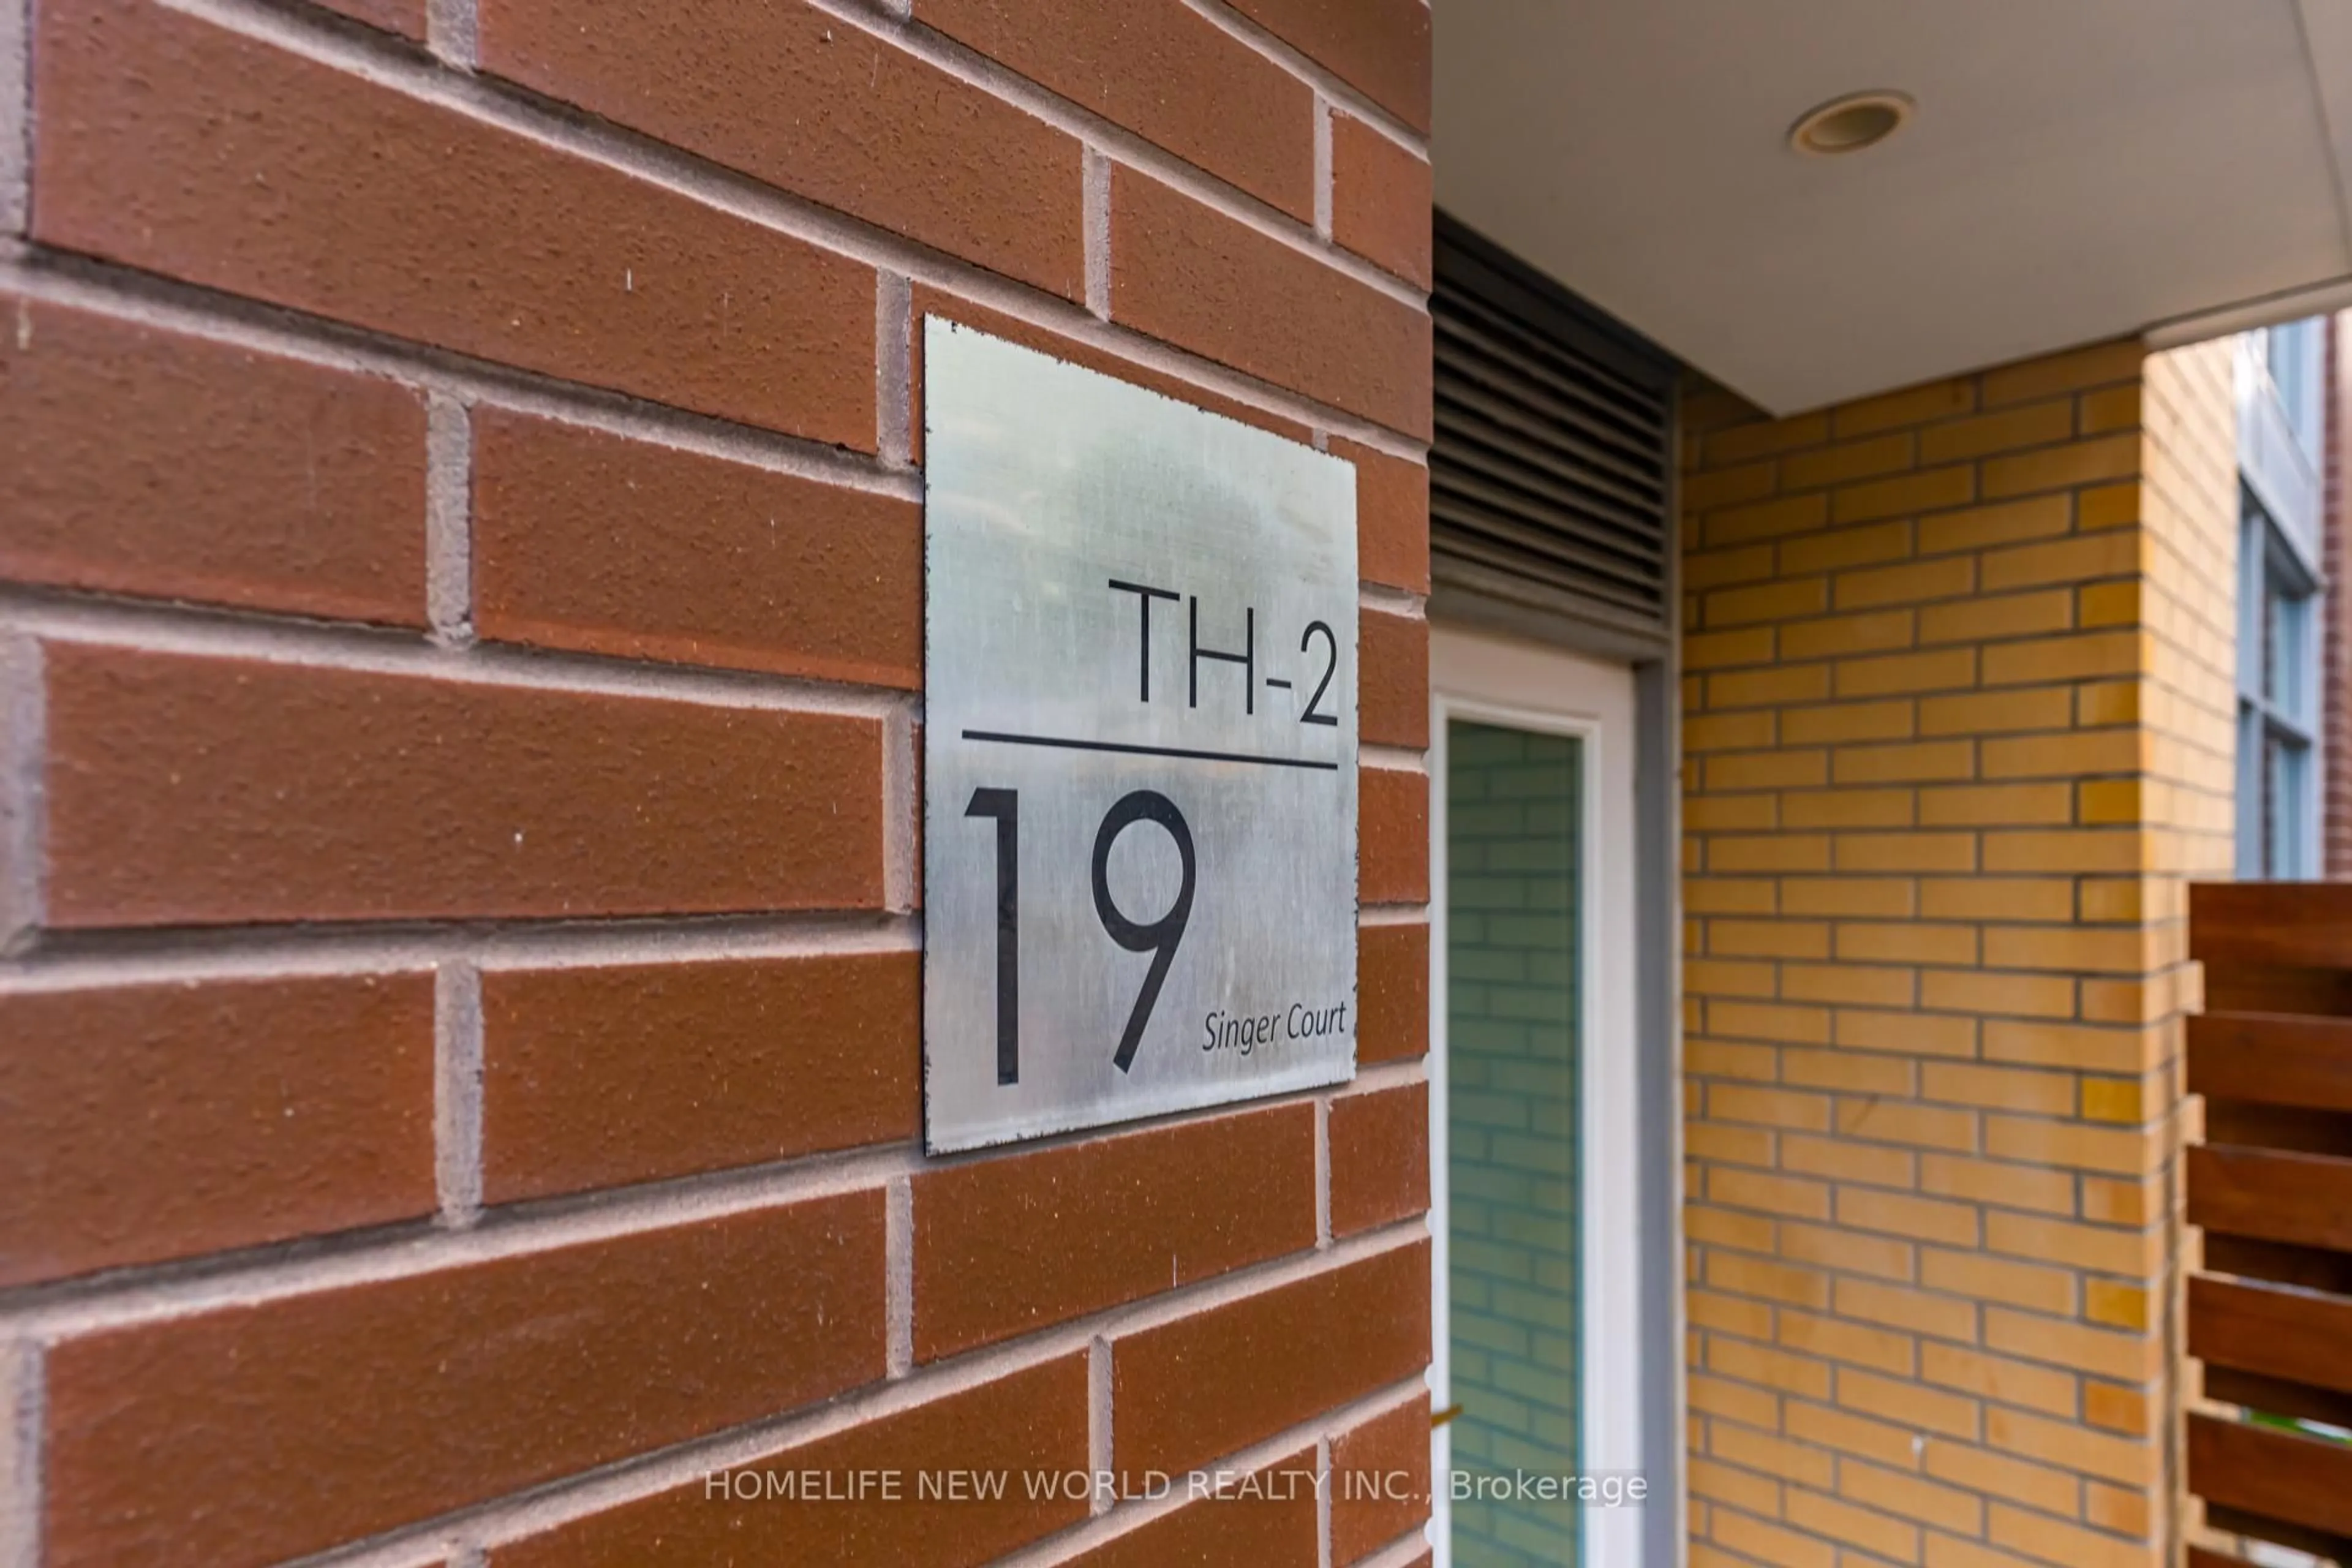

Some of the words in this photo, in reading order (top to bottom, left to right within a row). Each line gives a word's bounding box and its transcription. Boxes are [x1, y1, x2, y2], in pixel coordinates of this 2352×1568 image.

[1108, 578, 1338, 726] TH-2
[963, 786, 1196, 1086] 19
[1202, 1010, 1281, 1056] Singer
[1287, 1001, 1347, 1039] Court
